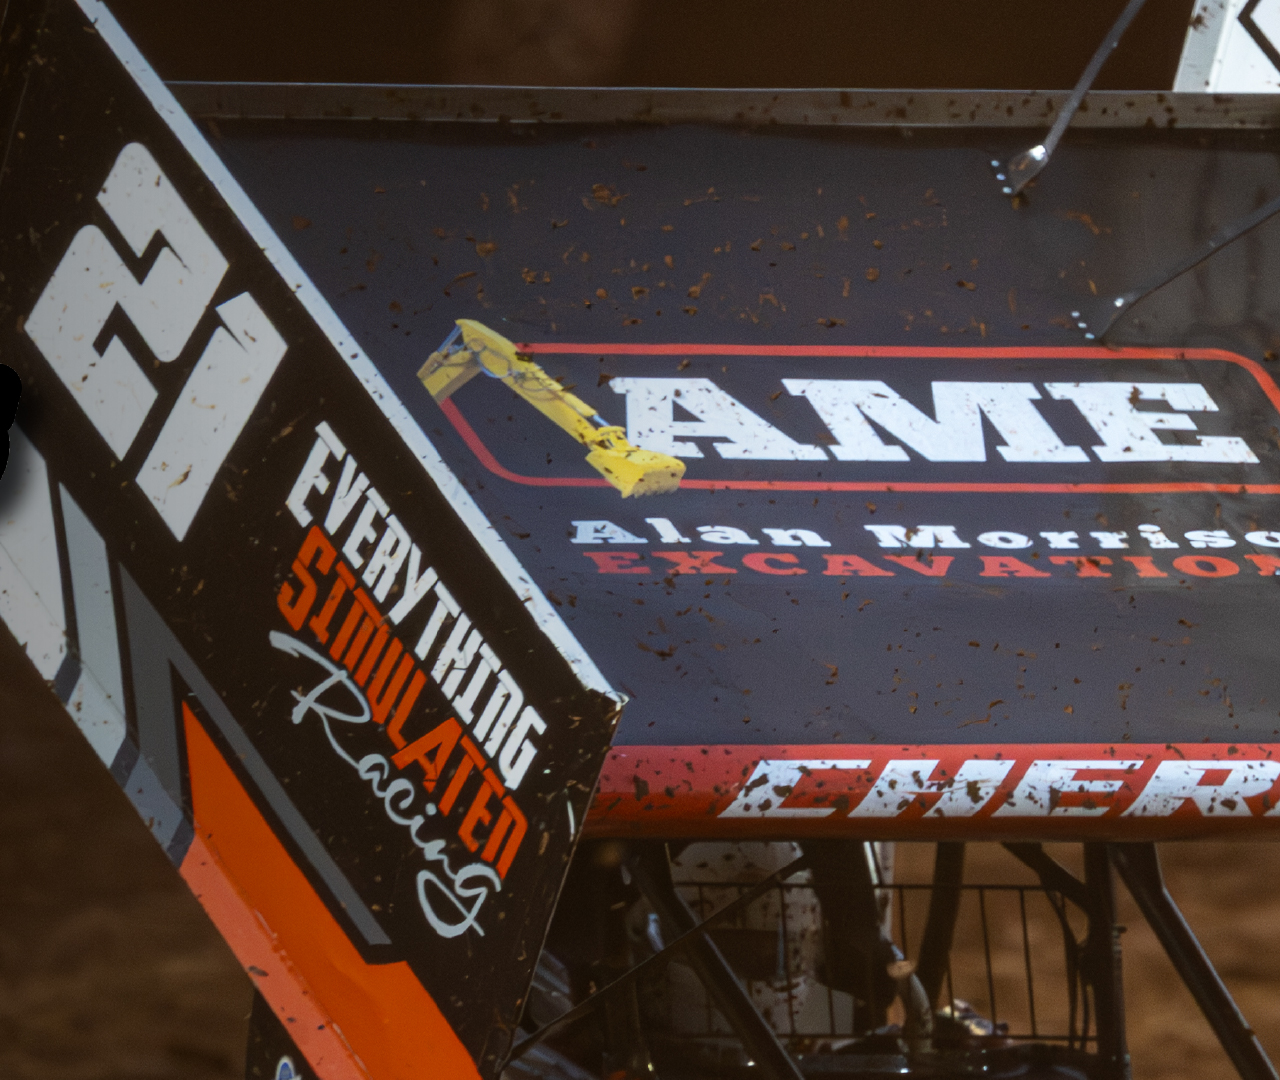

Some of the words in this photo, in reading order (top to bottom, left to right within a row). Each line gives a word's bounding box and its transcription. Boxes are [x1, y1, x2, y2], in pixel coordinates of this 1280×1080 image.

[23, 142, 288, 542] 21
[608, 376, 1260, 464] AME
[276, 525, 529, 882] SIMULATED
[285, 420, 548, 791] EVERYTHING
[569, 518, 831, 548] Alan
